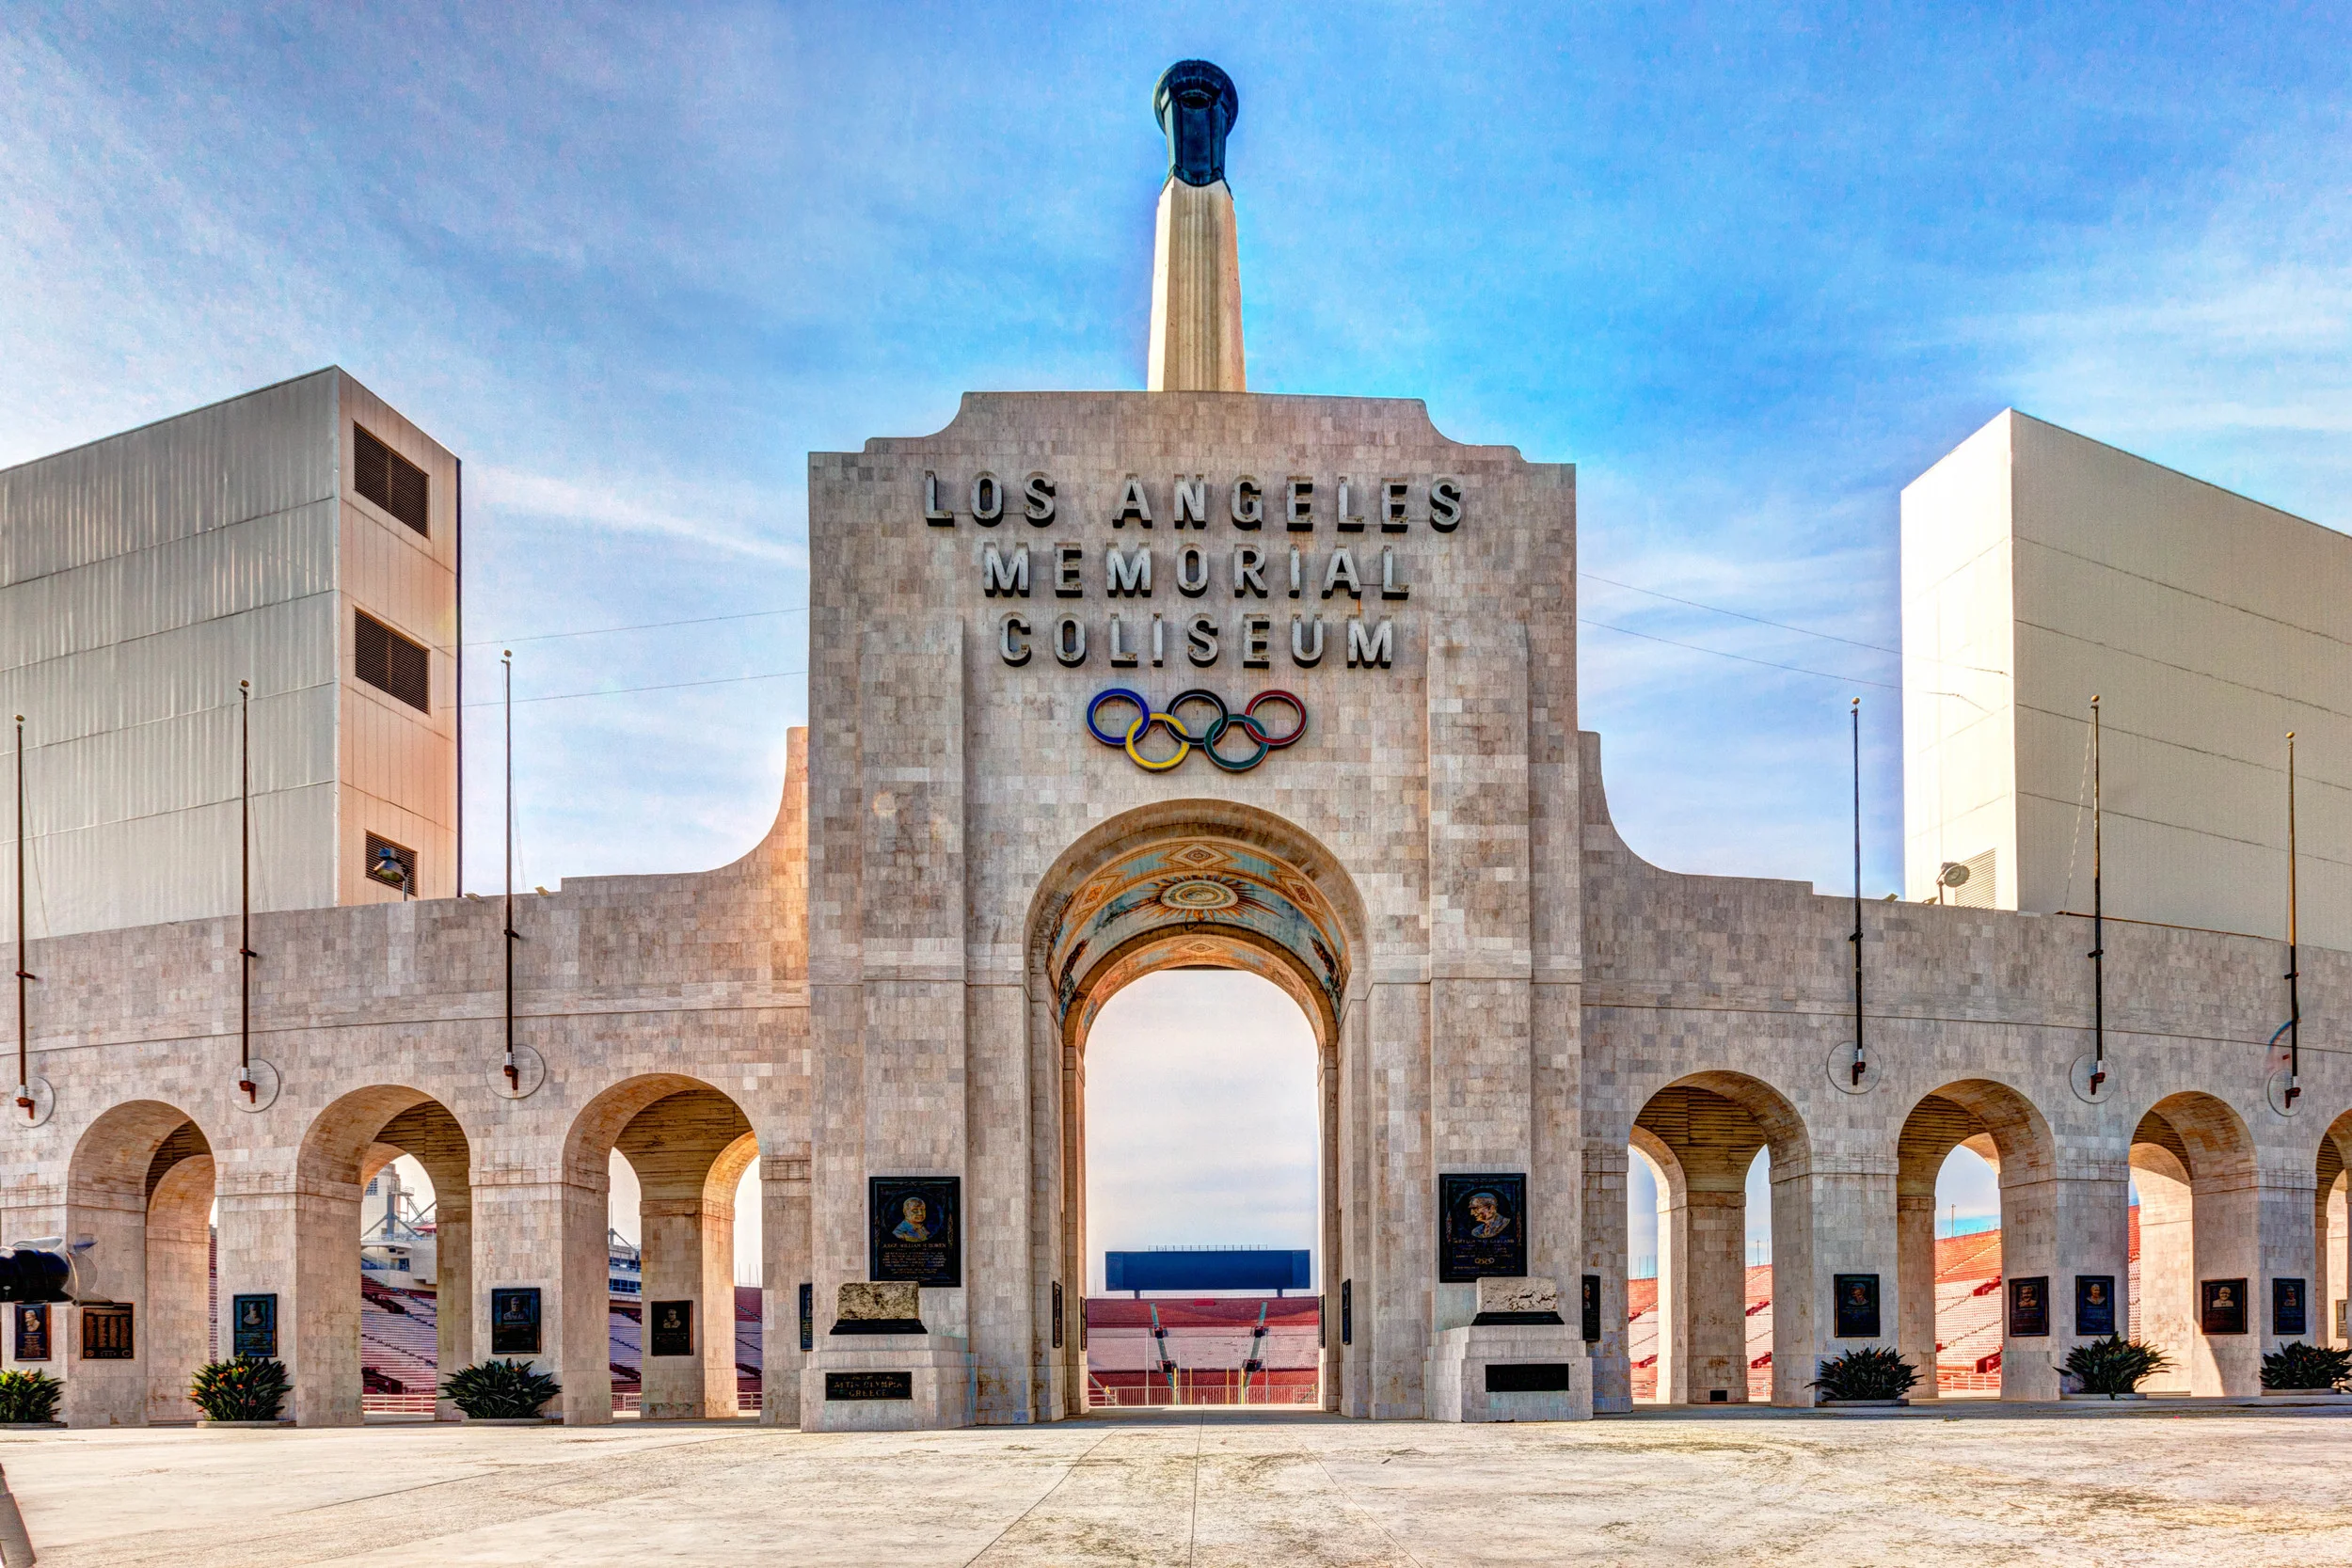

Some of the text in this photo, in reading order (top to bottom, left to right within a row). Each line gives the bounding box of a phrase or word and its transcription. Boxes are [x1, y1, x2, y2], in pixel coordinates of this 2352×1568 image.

[925, 470, 1461, 533] LOS ANGELES
[983, 541, 1409, 600] MEMORIAL
[998, 611, 1392, 669] COLISEUM
[849, 1389, 887, 1398] GREECE
